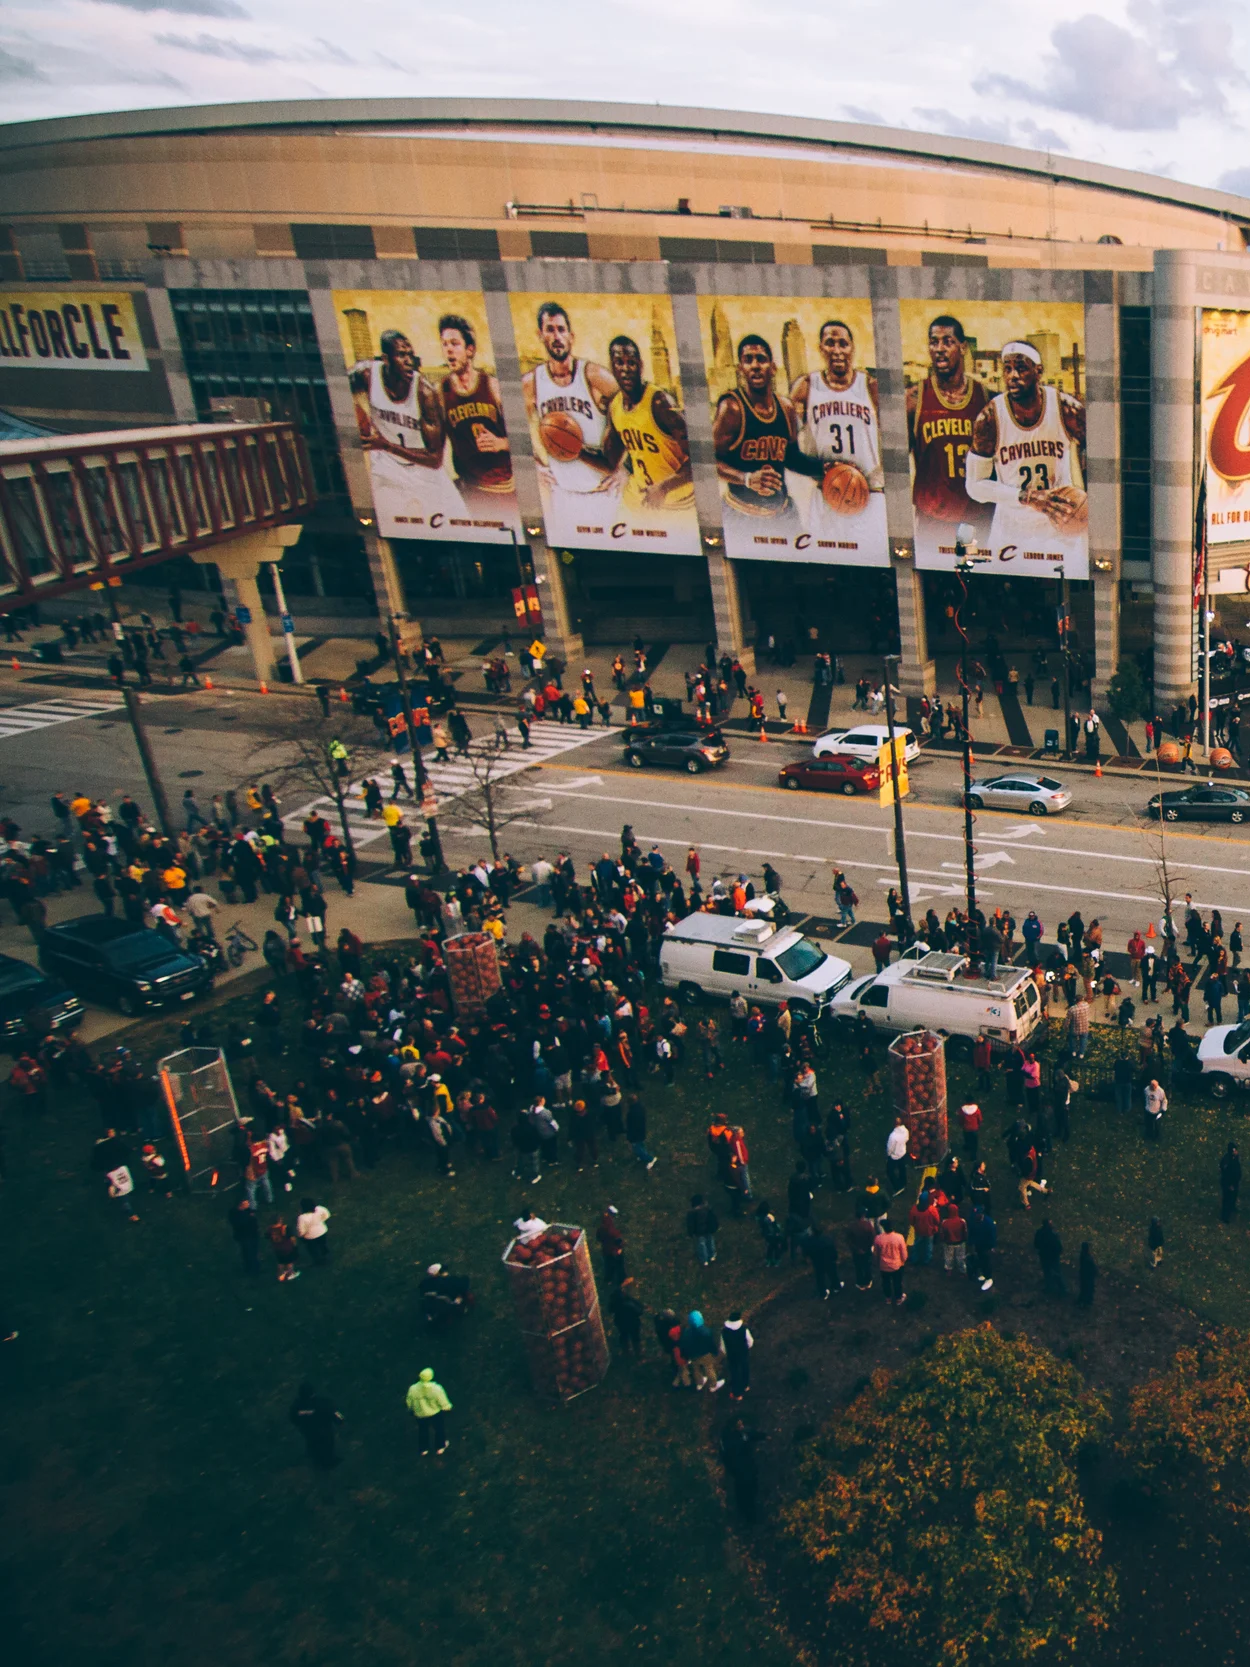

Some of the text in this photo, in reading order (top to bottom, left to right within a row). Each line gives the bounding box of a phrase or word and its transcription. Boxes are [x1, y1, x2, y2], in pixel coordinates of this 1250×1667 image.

[540, 396, 594, 420] CAVALIERS
[812, 401, 871, 425] CAVALIERS
[622, 429, 660, 453] AVS
[829, 423, 856, 454] 31
[922, 418, 973, 444] CLEVELA
[944, 442, 970, 478] 13
[1000, 440, 1064, 465] CAVALIERS
[1019, 463, 1050, 491] 23
[1211, 512, 1225, 525] ALL
[1227, 510, 1241, 523] FOR
